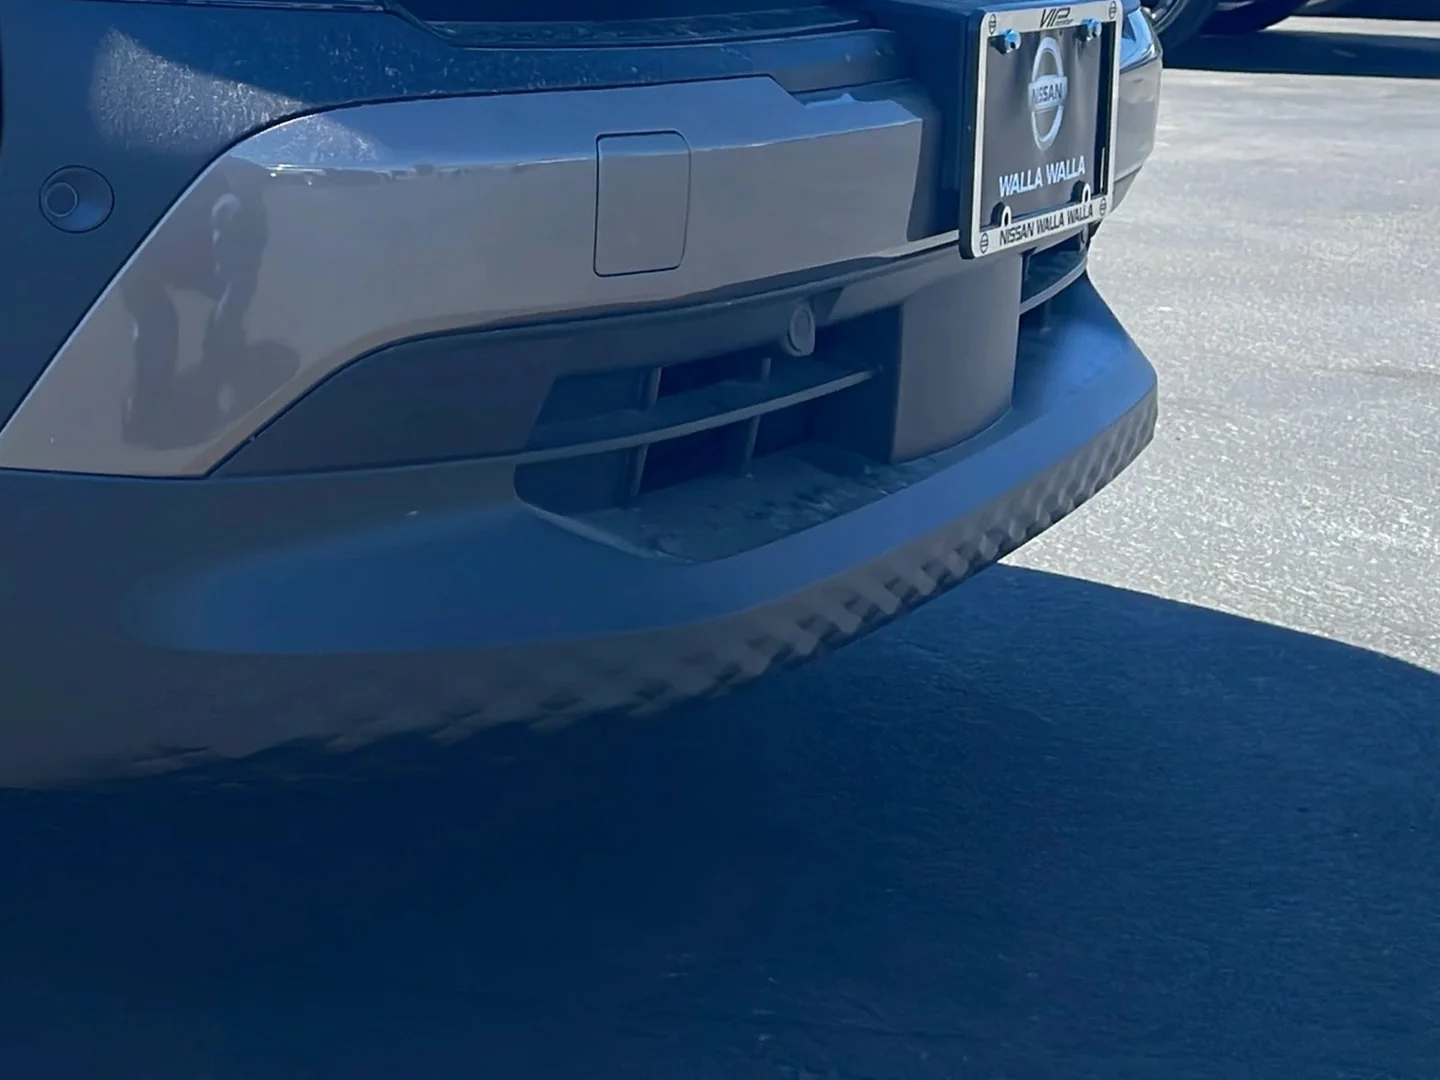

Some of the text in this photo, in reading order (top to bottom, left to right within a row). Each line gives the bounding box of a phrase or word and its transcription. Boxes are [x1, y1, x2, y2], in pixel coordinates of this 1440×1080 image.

[1040, 7, 1071, 28] VIP
[1032, 82, 1063, 103] NISSAN
[999, 155, 1085, 198] WALLA WALLA
[1000, 204, 1093, 246] NISSAN WALLA WALLA
